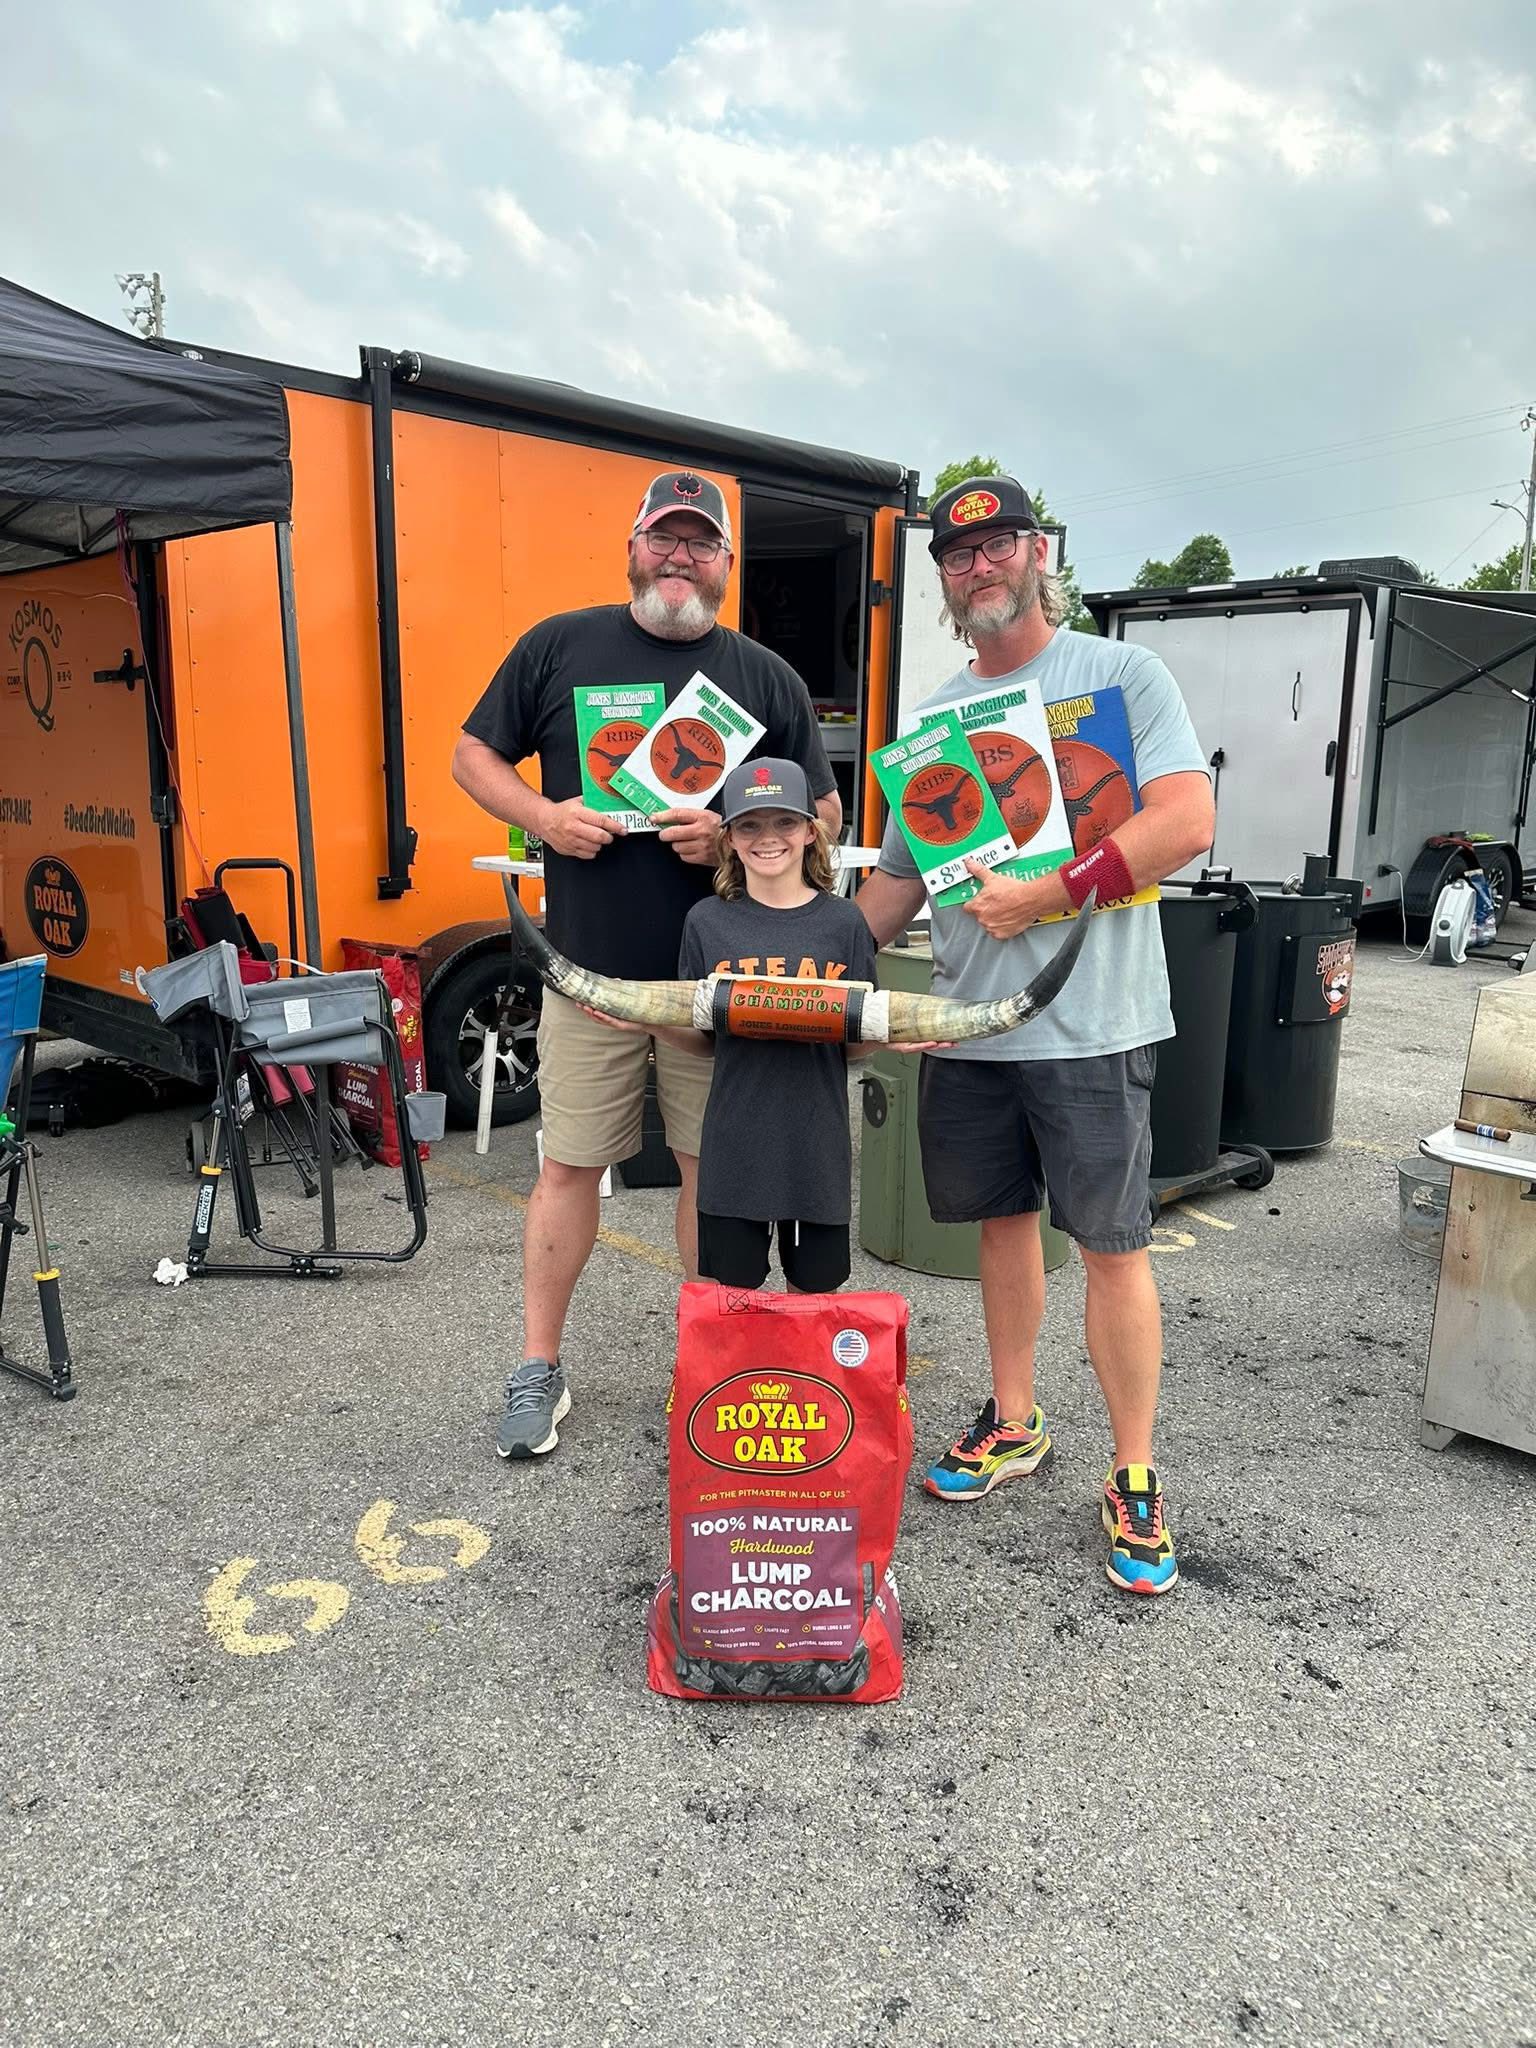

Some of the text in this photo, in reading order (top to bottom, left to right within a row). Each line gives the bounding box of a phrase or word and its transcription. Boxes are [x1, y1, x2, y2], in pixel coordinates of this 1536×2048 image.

[956, 498, 992, 515] ROYAL
[964, 508, 987, 521] OAK
[9, 600, 62, 653] KOSMOS
[960, 690, 1027, 720] LONGHORN
[1045, 695, 1095, 724] NGHORN
[718, 702, 754, 738] LONGHORN
[606, 730, 645, 742] RIBS
[687, 726, 718, 756] RIBS
[907, 723, 952, 756] LONGHORN
[916, 770, 955, 794] RIBS
[64, 804, 135, 840] #DeadBirdWalkin
[940, 864, 962, 885] 8th
[34, 885, 77, 917] ROYAL
[43, 918, 73, 947] OAK
[733, 994, 843, 1014] CHAMPION
[754, 985, 823, 998] GRAND
[346, 1079, 368, 1095] LUMP
[200, 1190, 211, 1229] ROCKER
[715, 1402, 827, 1433] ROYAL
[734, 1435, 808, 1464] OAK
[700, 1493, 718, 1502] FOR
[719, 1491, 737, 1500] THE
[738, 1489, 787, 1498] PITMASTER
[800, 1491, 817, 1499] ALL
[691, 1515, 853, 1537] 100% NATURAL
[730, 1538, 815, 1555] Hardwood
[731, 1561, 812, 1585] LUMP
[690, 1587, 851, 1613] CHARCOAL
